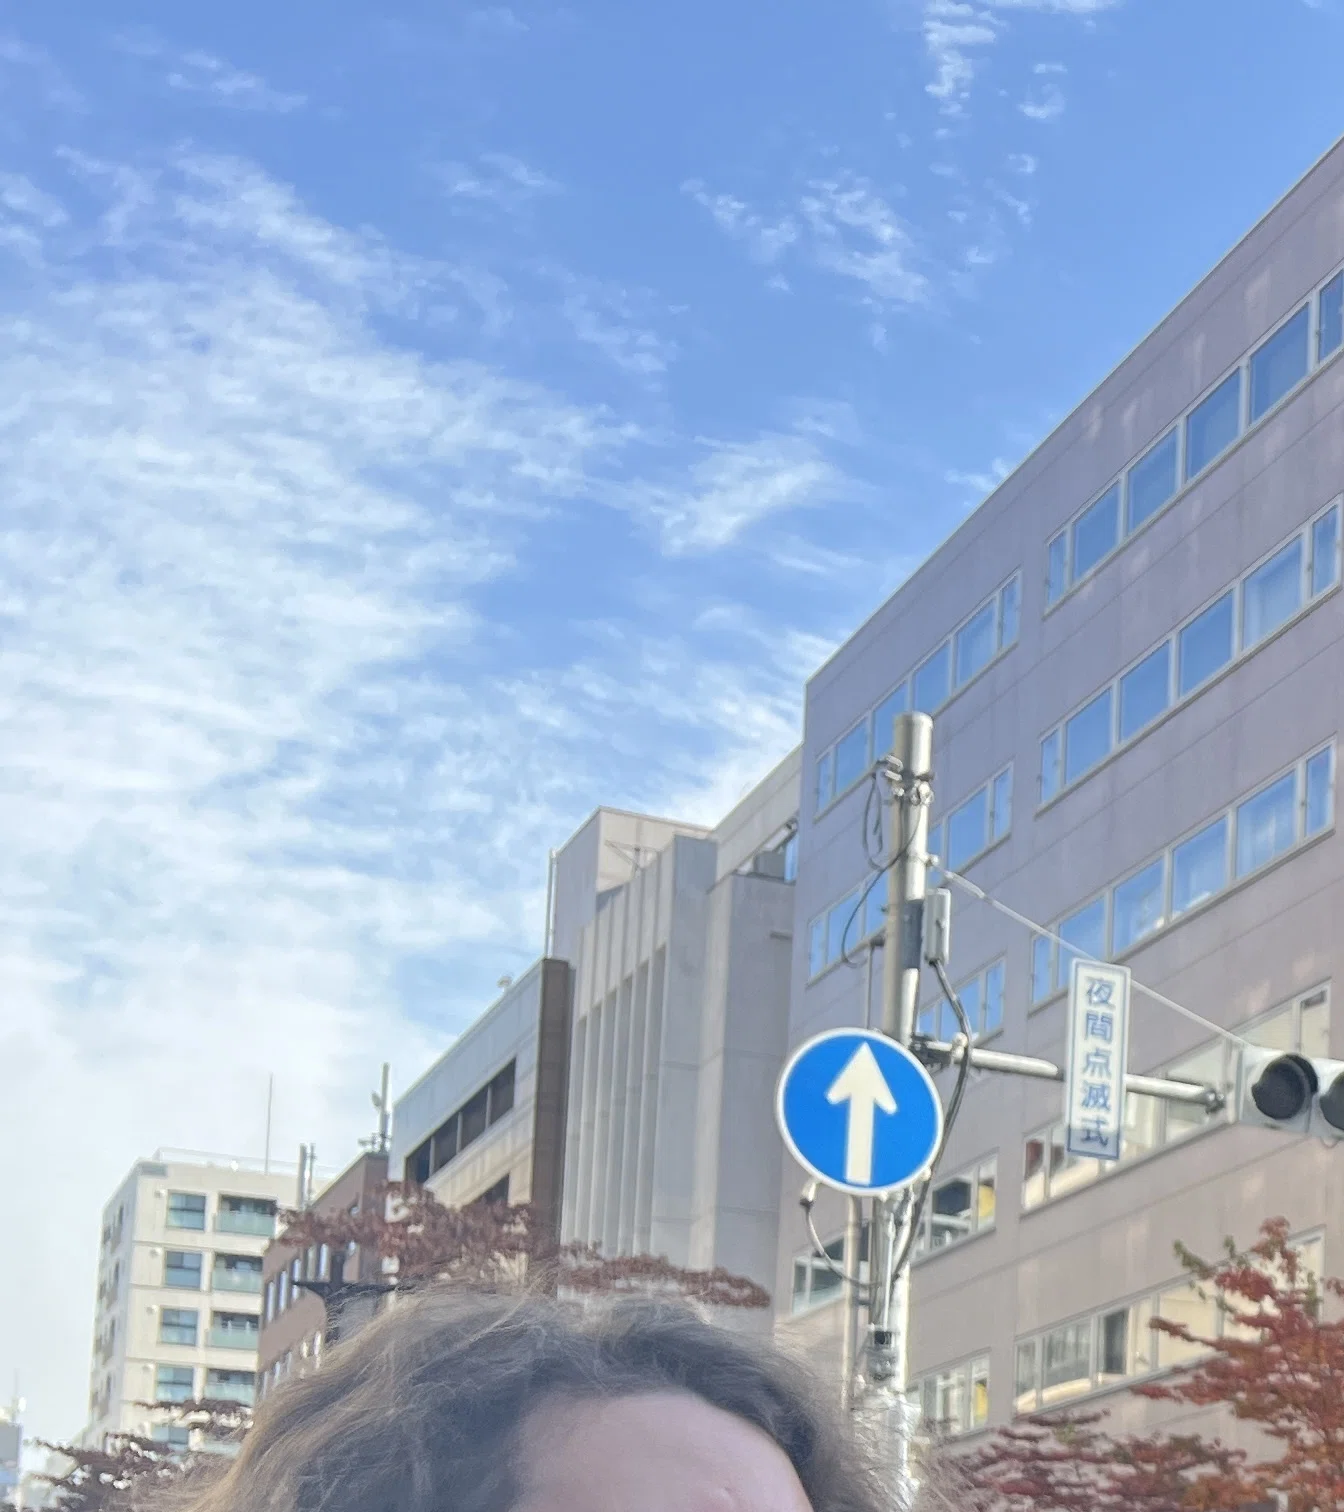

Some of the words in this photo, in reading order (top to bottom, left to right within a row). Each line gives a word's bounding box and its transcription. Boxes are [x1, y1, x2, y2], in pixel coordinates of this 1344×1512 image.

[1081, 975, 1116, 1147] 夜間点滅式
